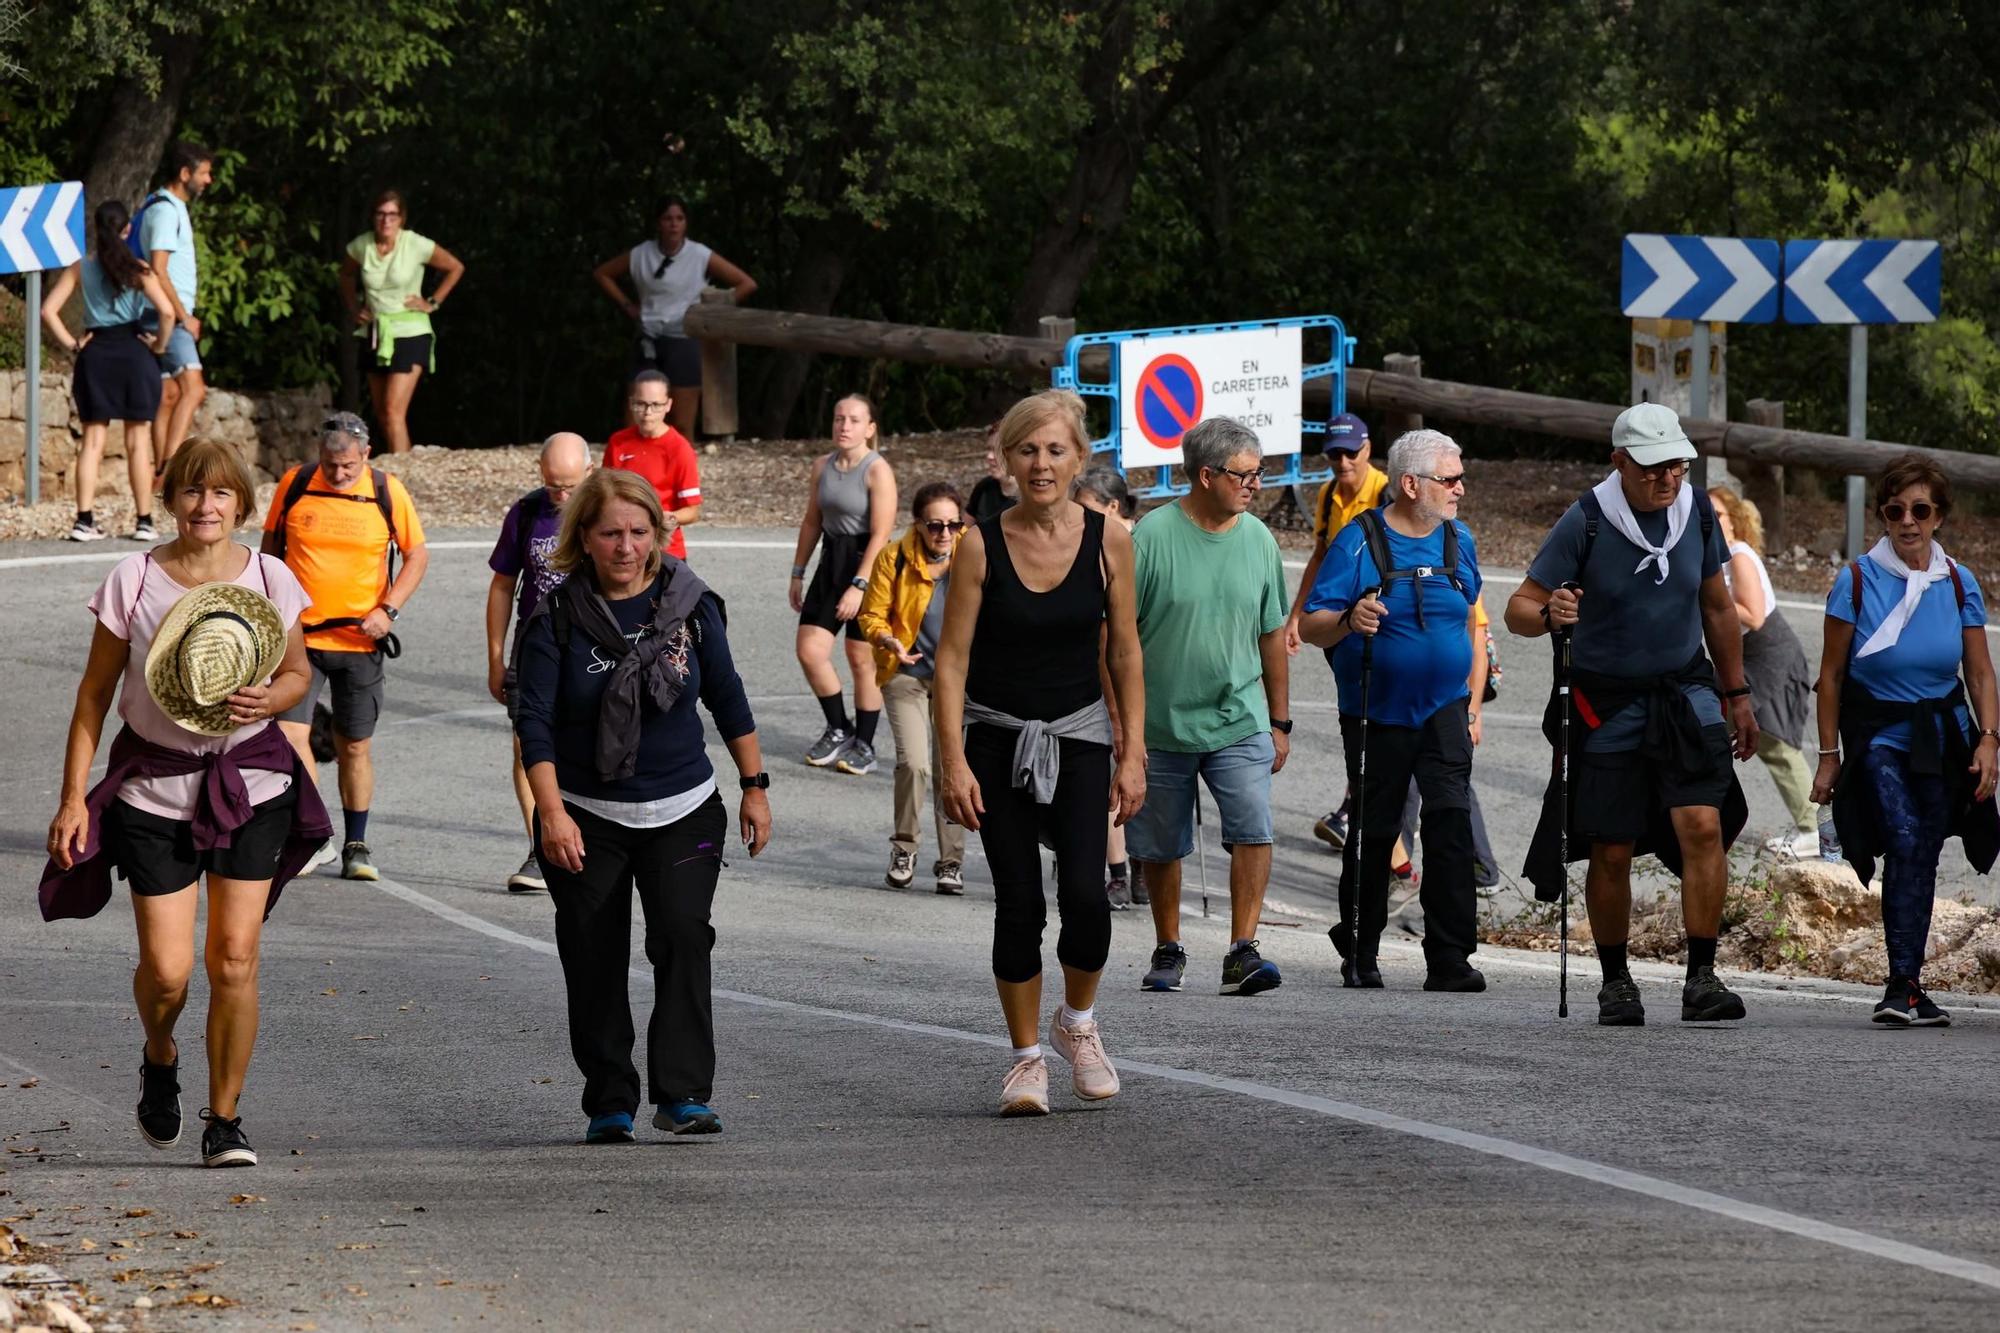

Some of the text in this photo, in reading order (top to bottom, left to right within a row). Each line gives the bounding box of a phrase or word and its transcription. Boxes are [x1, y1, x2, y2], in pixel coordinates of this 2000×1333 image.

[1242, 360, 1258, 374] EN
[1212, 375, 1289, 394] CARRETERA
[1247, 396, 1255, 409] Y
